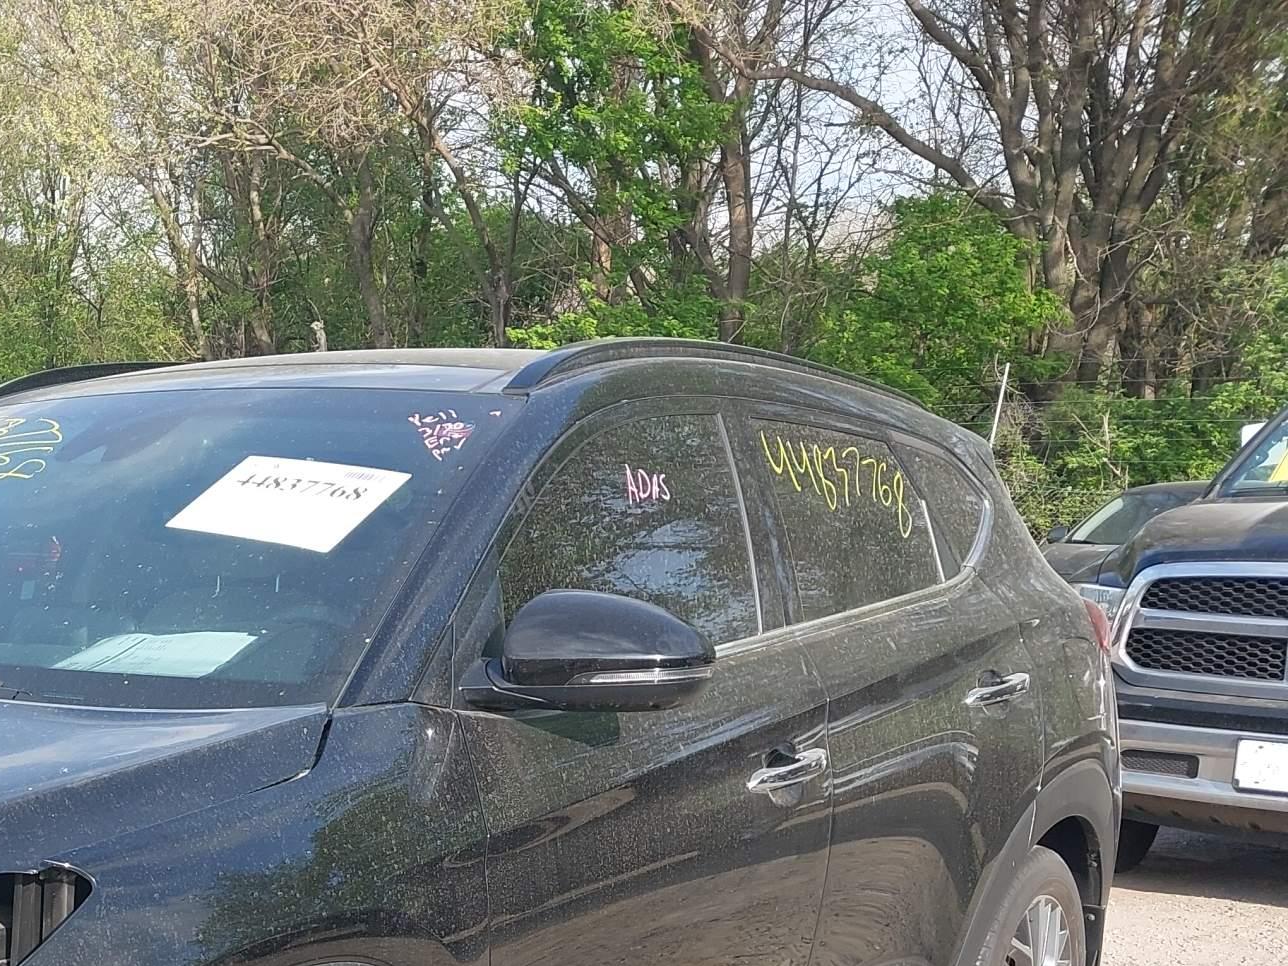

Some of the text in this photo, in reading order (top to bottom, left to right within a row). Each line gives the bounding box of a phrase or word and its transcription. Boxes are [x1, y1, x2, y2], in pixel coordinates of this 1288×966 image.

[236, 472, 369, 502] 44837768
[624, 462, 671, 505] ADAS
[760, 429, 914, 539] 44837768
